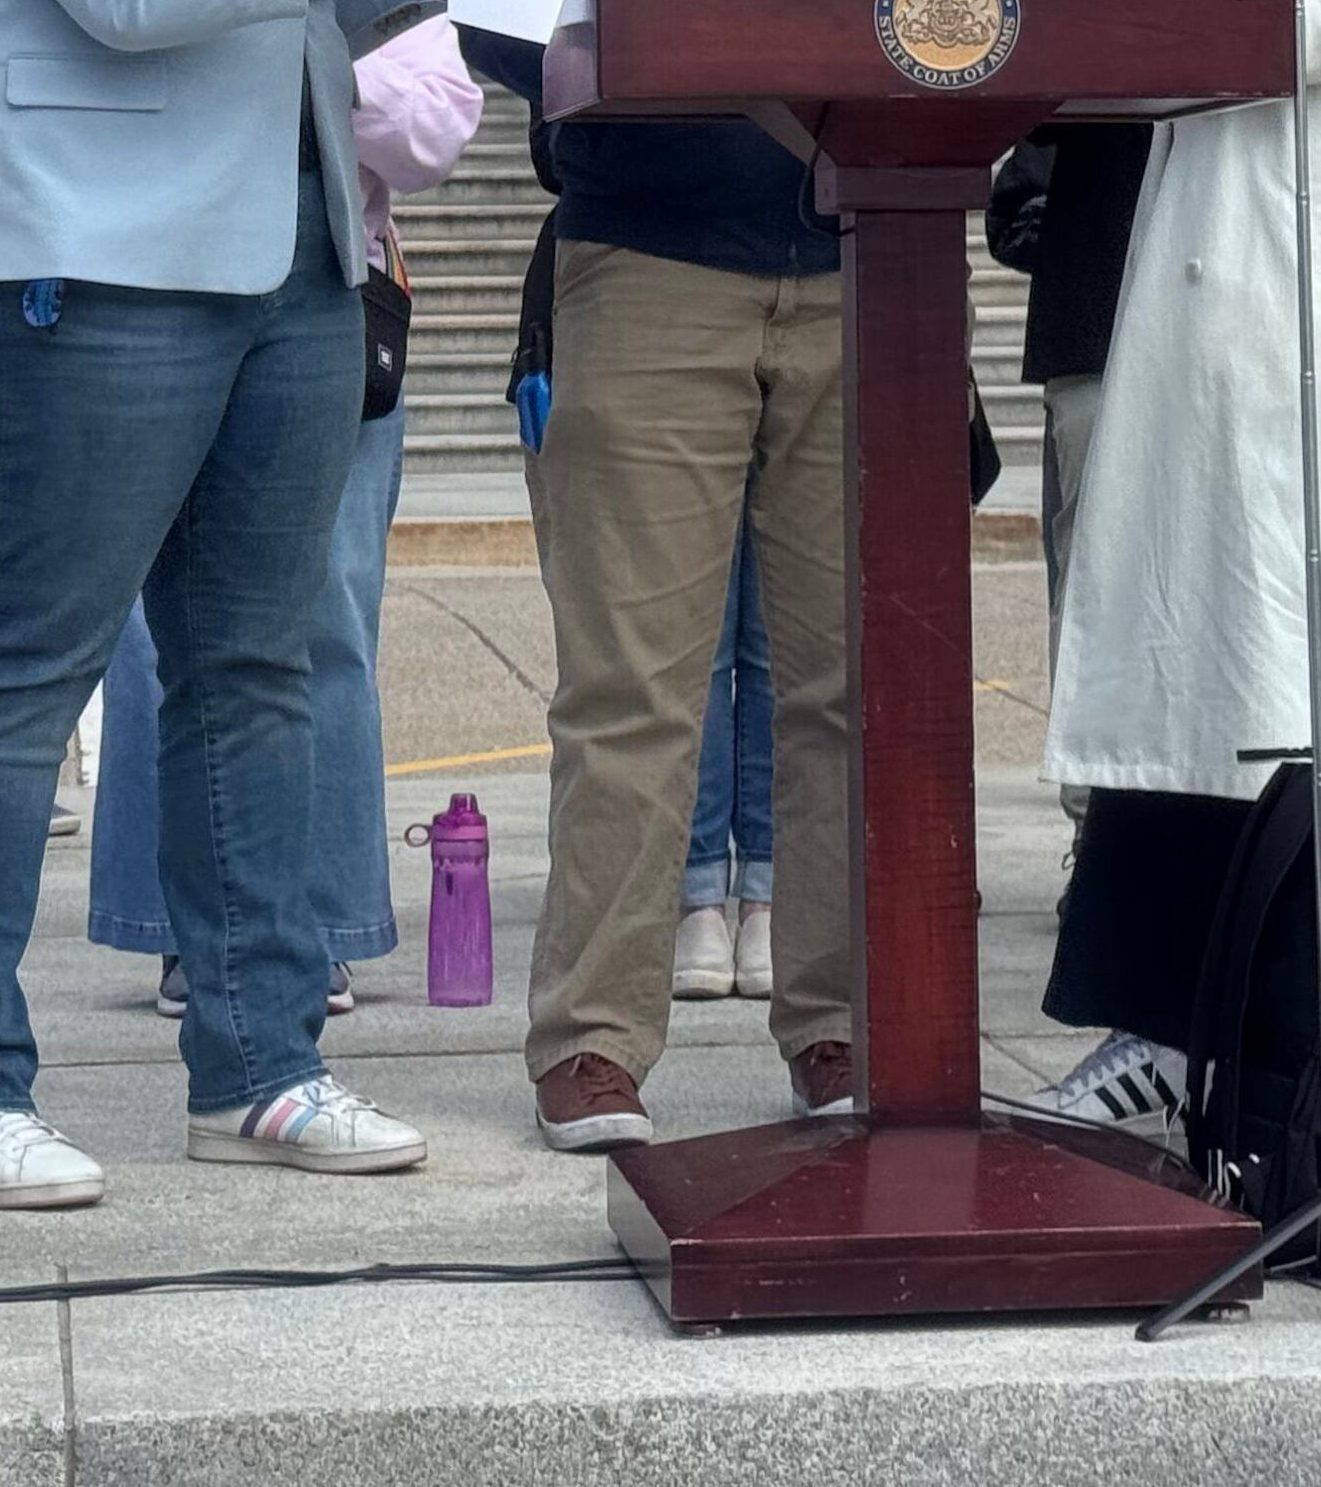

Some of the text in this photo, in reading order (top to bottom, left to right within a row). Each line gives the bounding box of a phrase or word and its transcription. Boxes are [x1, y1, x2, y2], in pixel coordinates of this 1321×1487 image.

[879, 15, 1016, 85] STATE COAT OF ARMS
